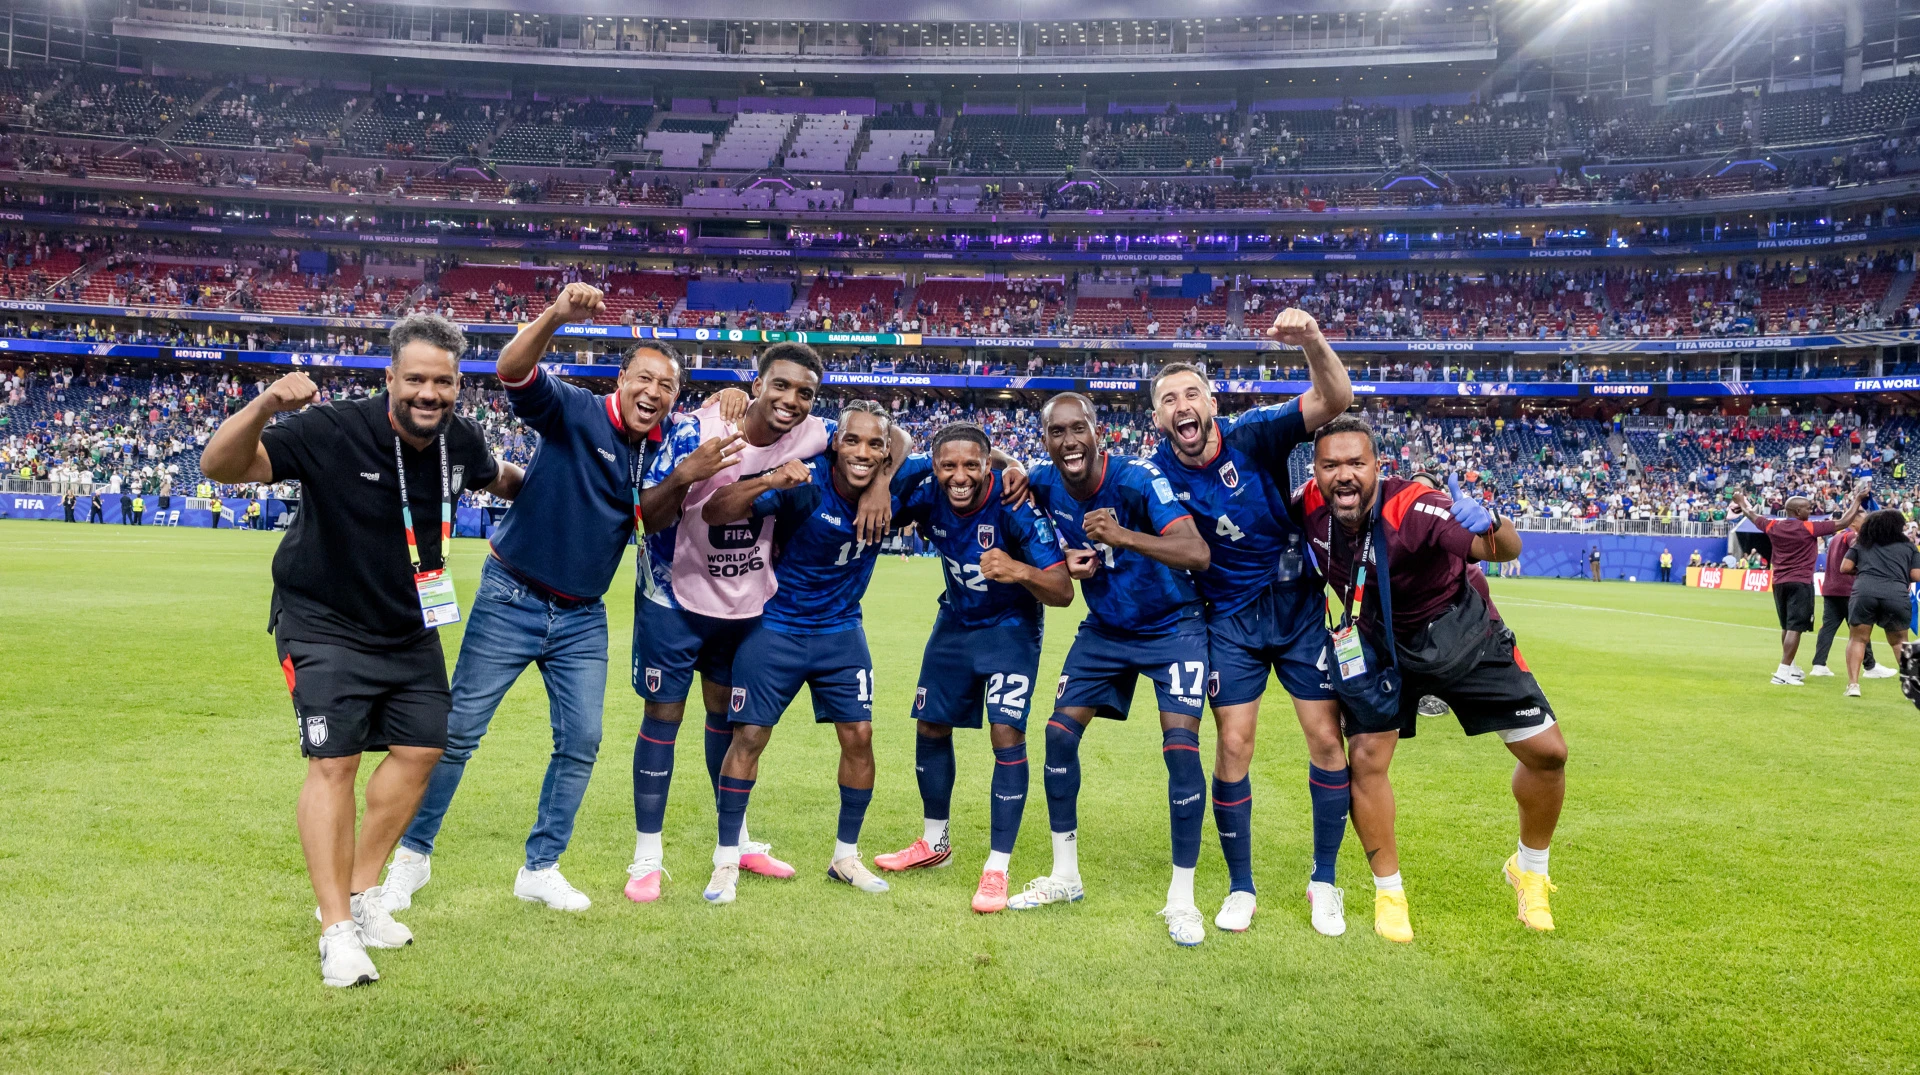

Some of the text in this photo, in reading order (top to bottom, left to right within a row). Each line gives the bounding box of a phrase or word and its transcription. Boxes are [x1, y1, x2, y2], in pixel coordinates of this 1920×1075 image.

[1778, 238, 1811, 247] WORLD
[1834, 234, 1867, 243] 2026
[850, 334, 877, 343] ARABIA
[1756, 339, 1791, 347] 2026
[175, 350, 222, 359] HOUSTON
[848, 375, 880, 383] WORLD
[881, 376, 899, 384] CUP
[1090, 381, 1136, 390] HOUSTON
[1855, 380, 1881, 389] FIFA
[1594, 385, 1648, 394] HOUSTON
[360, 472, 380, 480] capelli
[14, 498, 44, 510] FIFA
[821, 513, 841, 526] capelli
[1216, 514, 1245, 541] 4
[724, 529, 753, 540] FIFA
[707, 554, 746, 563] WORLD
[708, 557, 764, 577] 2026
[945, 555, 988, 592] 22
[1700, 567, 1721, 588] Lay's
[1744, 569, 1769, 592] Lay's
[1169, 661, 1204, 695] 17
[987, 673, 1029, 708] 22
[1178, 696, 1202, 708] capelli
[1000, 707, 1022, 719] capelli
[1516, 706, 1540, 717] capelli
